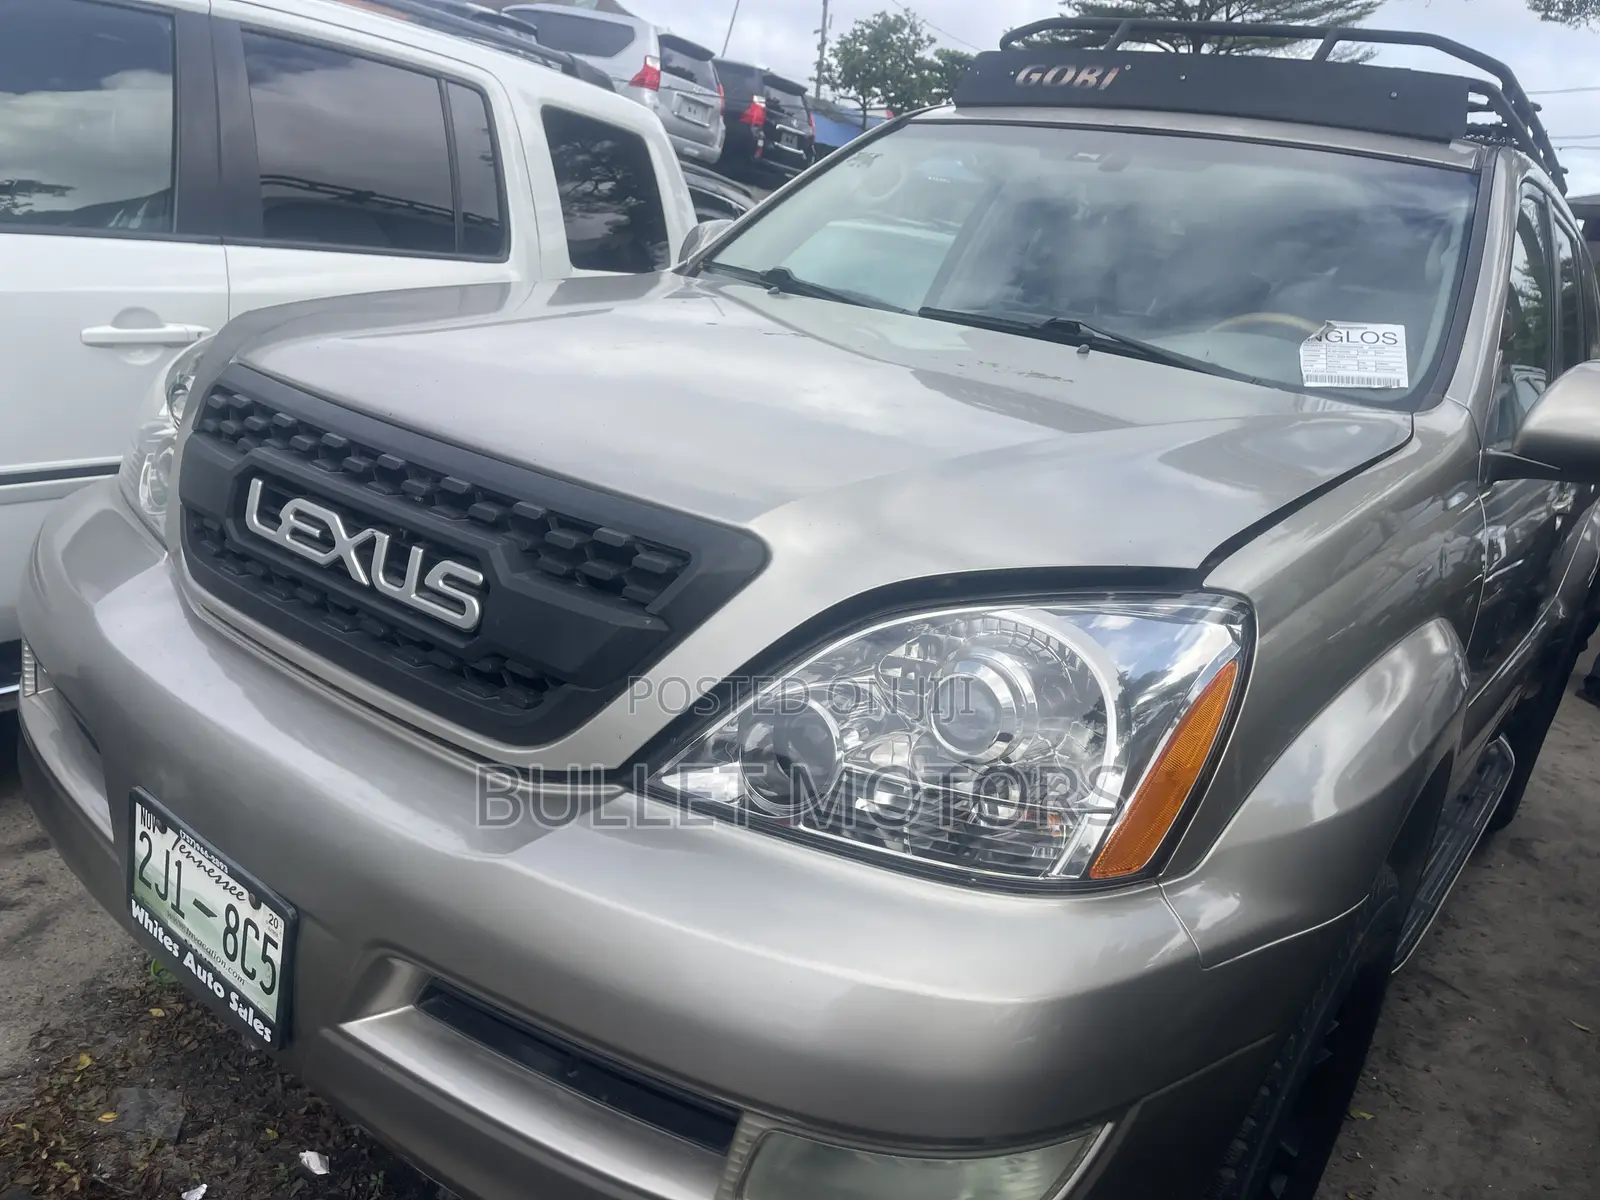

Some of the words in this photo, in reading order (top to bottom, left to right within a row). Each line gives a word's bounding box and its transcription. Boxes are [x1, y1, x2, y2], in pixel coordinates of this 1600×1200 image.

[1015, 64, 1119, 91] GOBI
[245, 477, 484, 632] LEXUS
[171, 834, 248, 902] Tennessee
[268, 913, 279, 930] 20
[131, 899, 180, 958] Whites
[182, 952, 226, 999] Auto
[229, 991, 273, 1044] Sales
